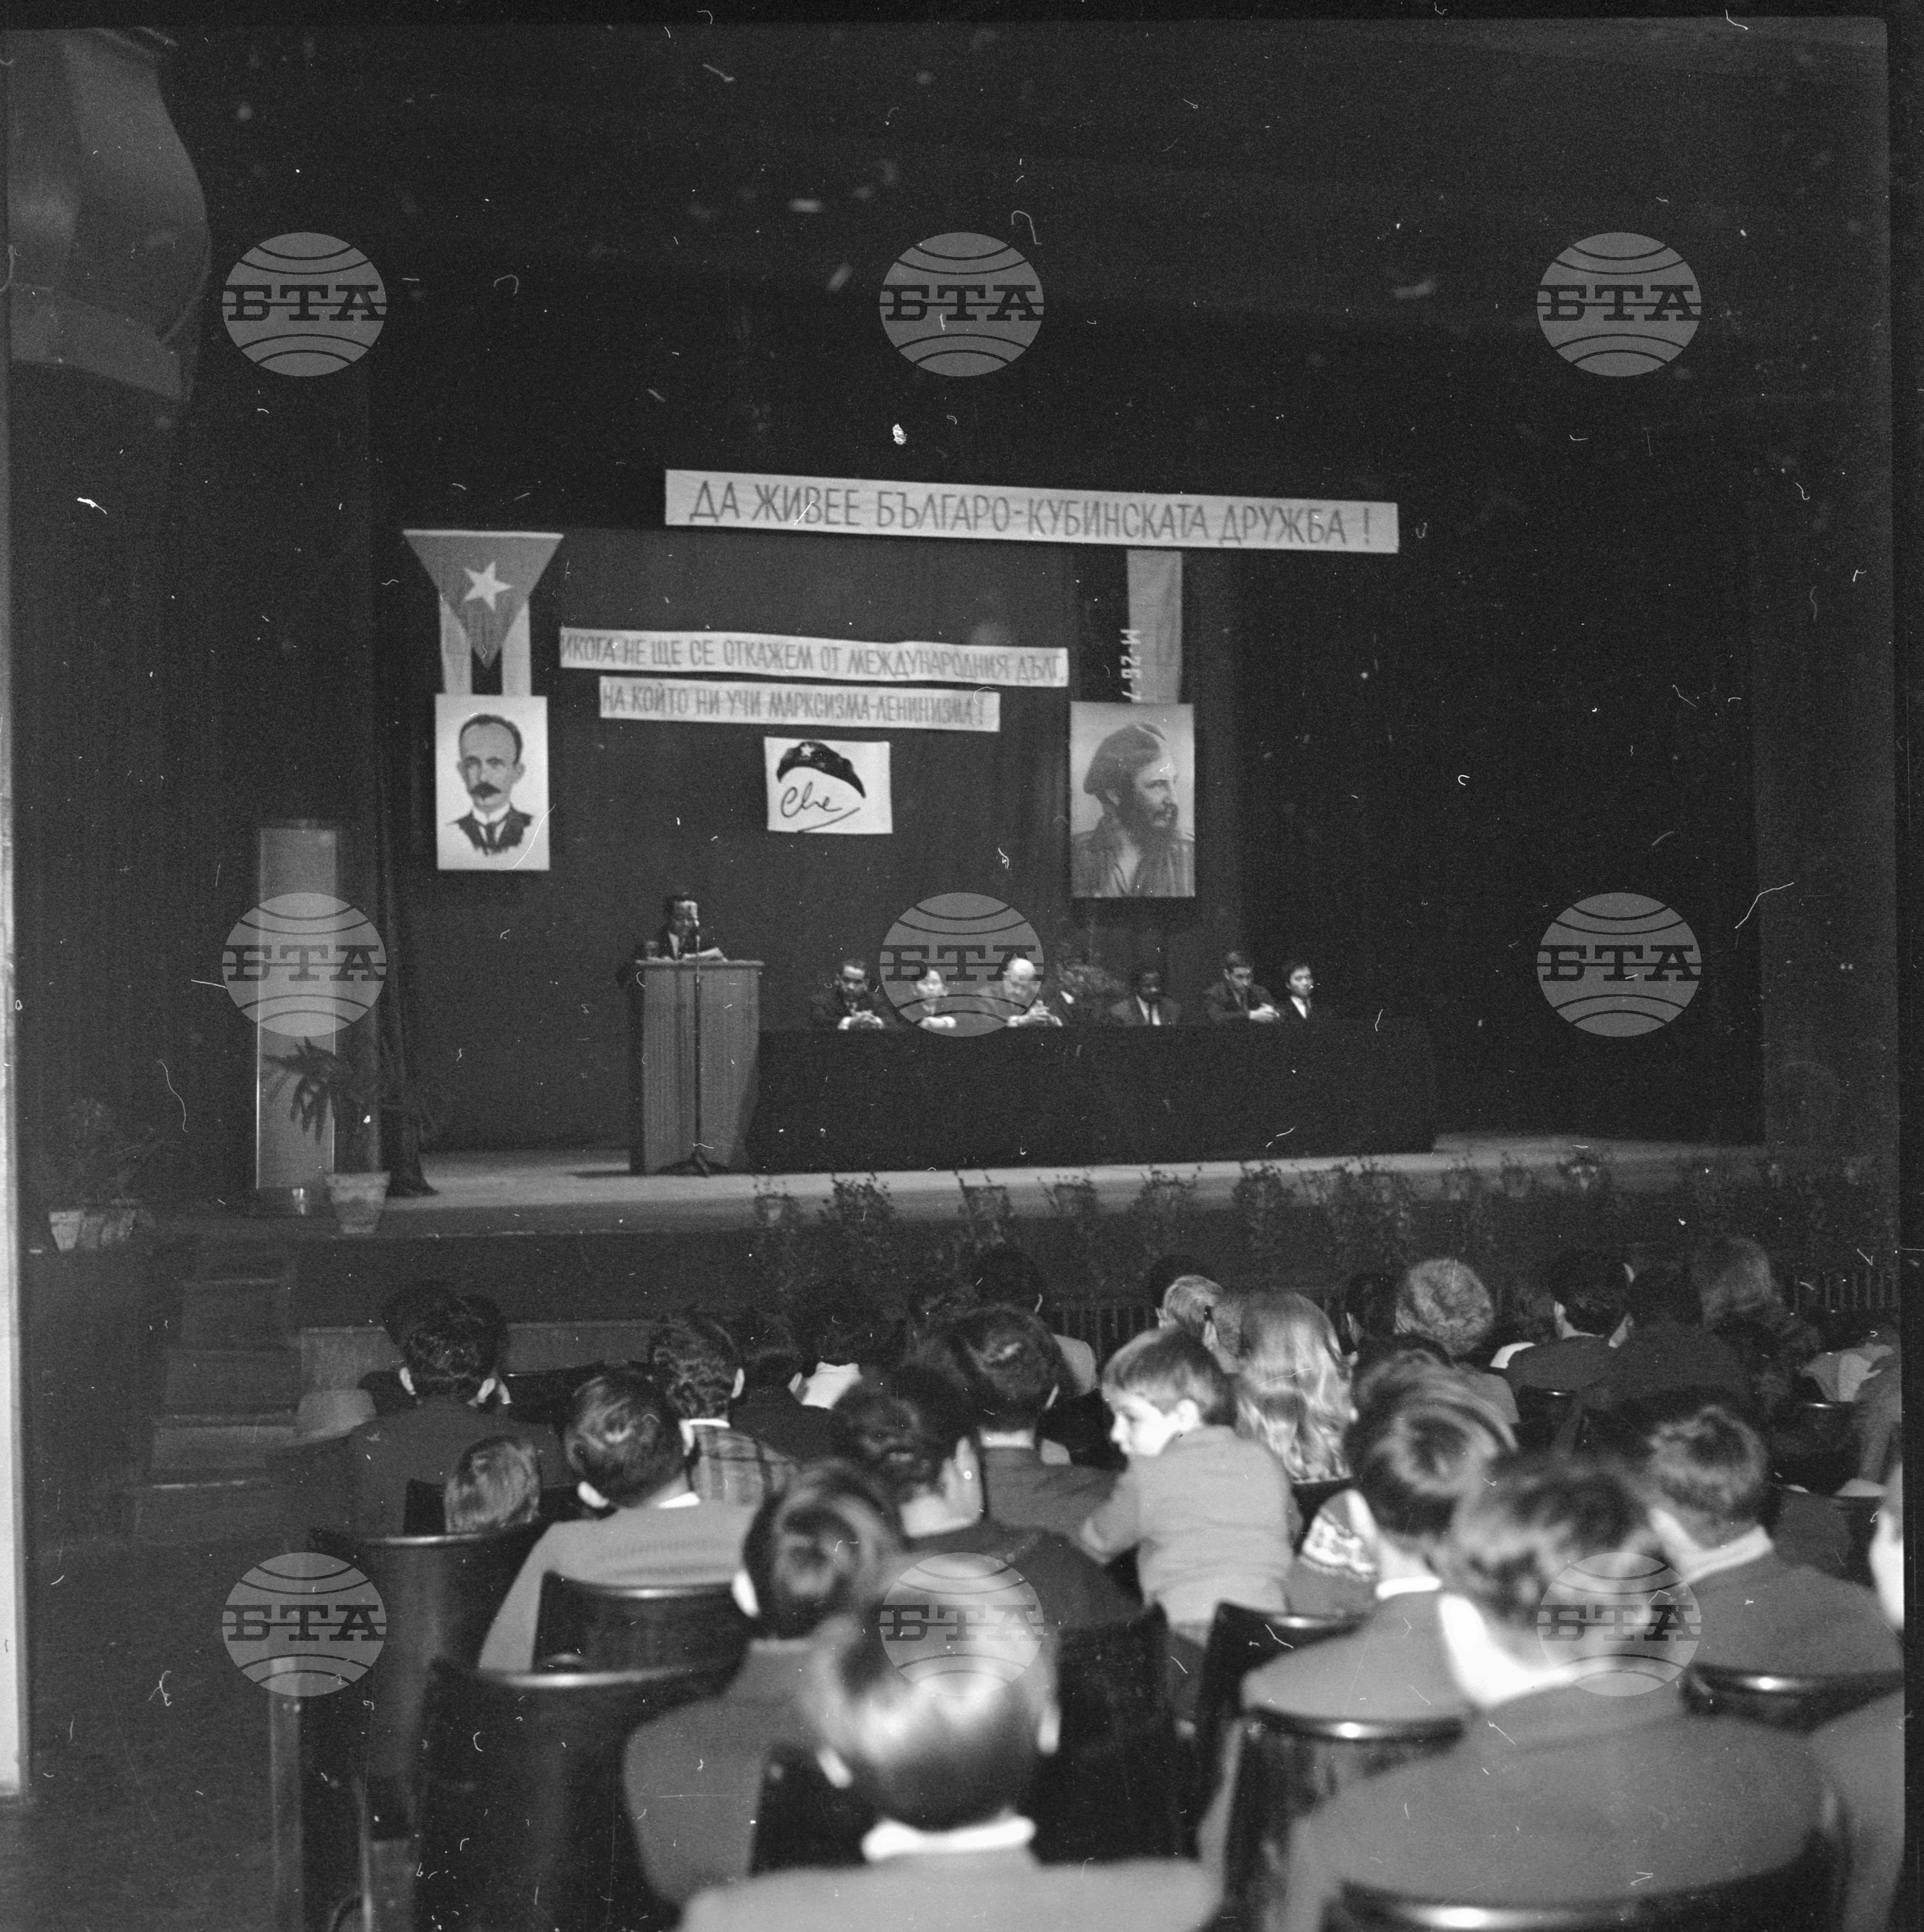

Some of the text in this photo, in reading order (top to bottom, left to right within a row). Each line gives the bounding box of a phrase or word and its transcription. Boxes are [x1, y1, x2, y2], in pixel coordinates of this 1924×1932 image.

[690, 481, 740, 522] ДА
[752, 484, 862, 526] ЖИВЕЕ
[877, 490, 1210, 540] БЪЛГАРО-КУБИНСКАТА
[623, 639, 647, 665] НЕ
[652, 640, 682, 668] ЩЕ
[690, 639, 713, 667] СЕ
[724, 640, 815, 671] ОТКАЖЕМ
[821, 646, 841, 672] ОТ
[847, 648, 1011, 680] МЕЖДУНАРОДНИЯ
[602, 683, 626, 713] НА
[696, 689, 720, 716] НИ
[726, 689, 761, 717] УЧИ
[781, 781, 843, 818] Che
